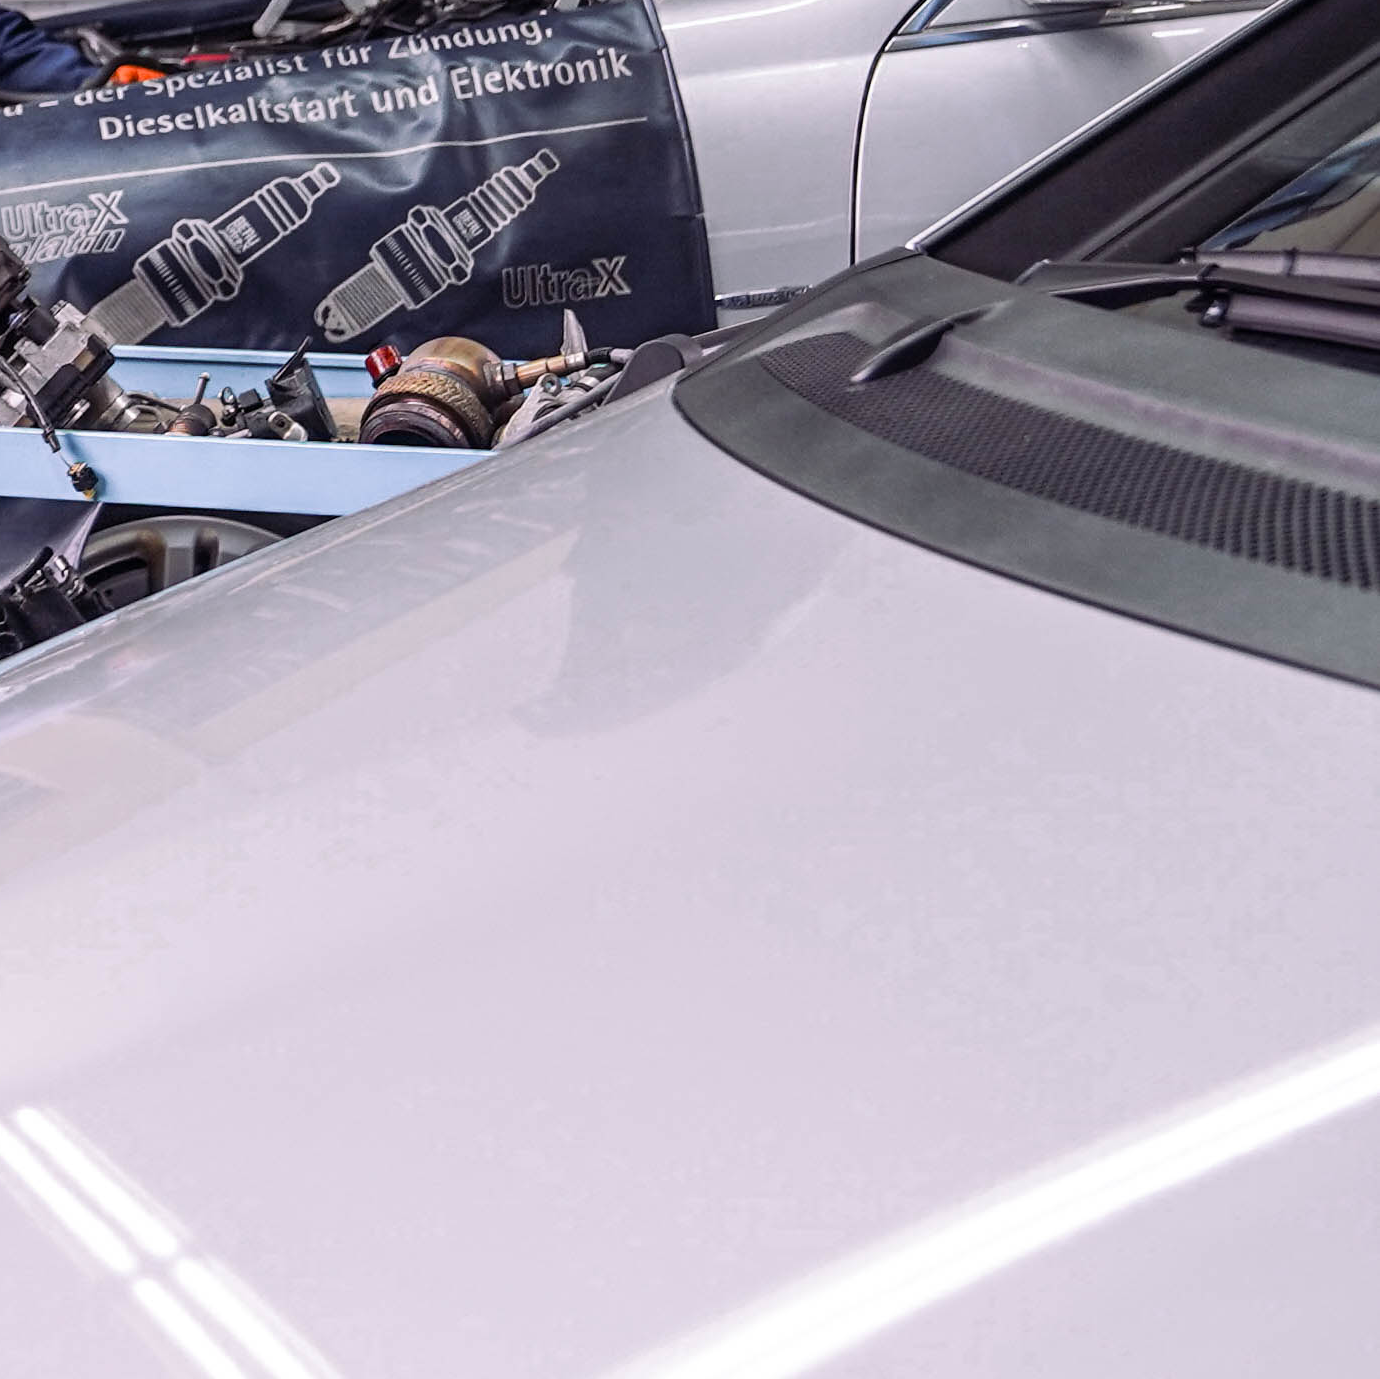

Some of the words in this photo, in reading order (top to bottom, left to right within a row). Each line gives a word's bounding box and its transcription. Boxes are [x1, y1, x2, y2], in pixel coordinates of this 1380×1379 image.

[73, 84, 129, 107] der
[99, 93, 359, 141] Dieselkaltstart
[371, 77, 439, 114] und
[450, 47, 632, 101] Elektronik
